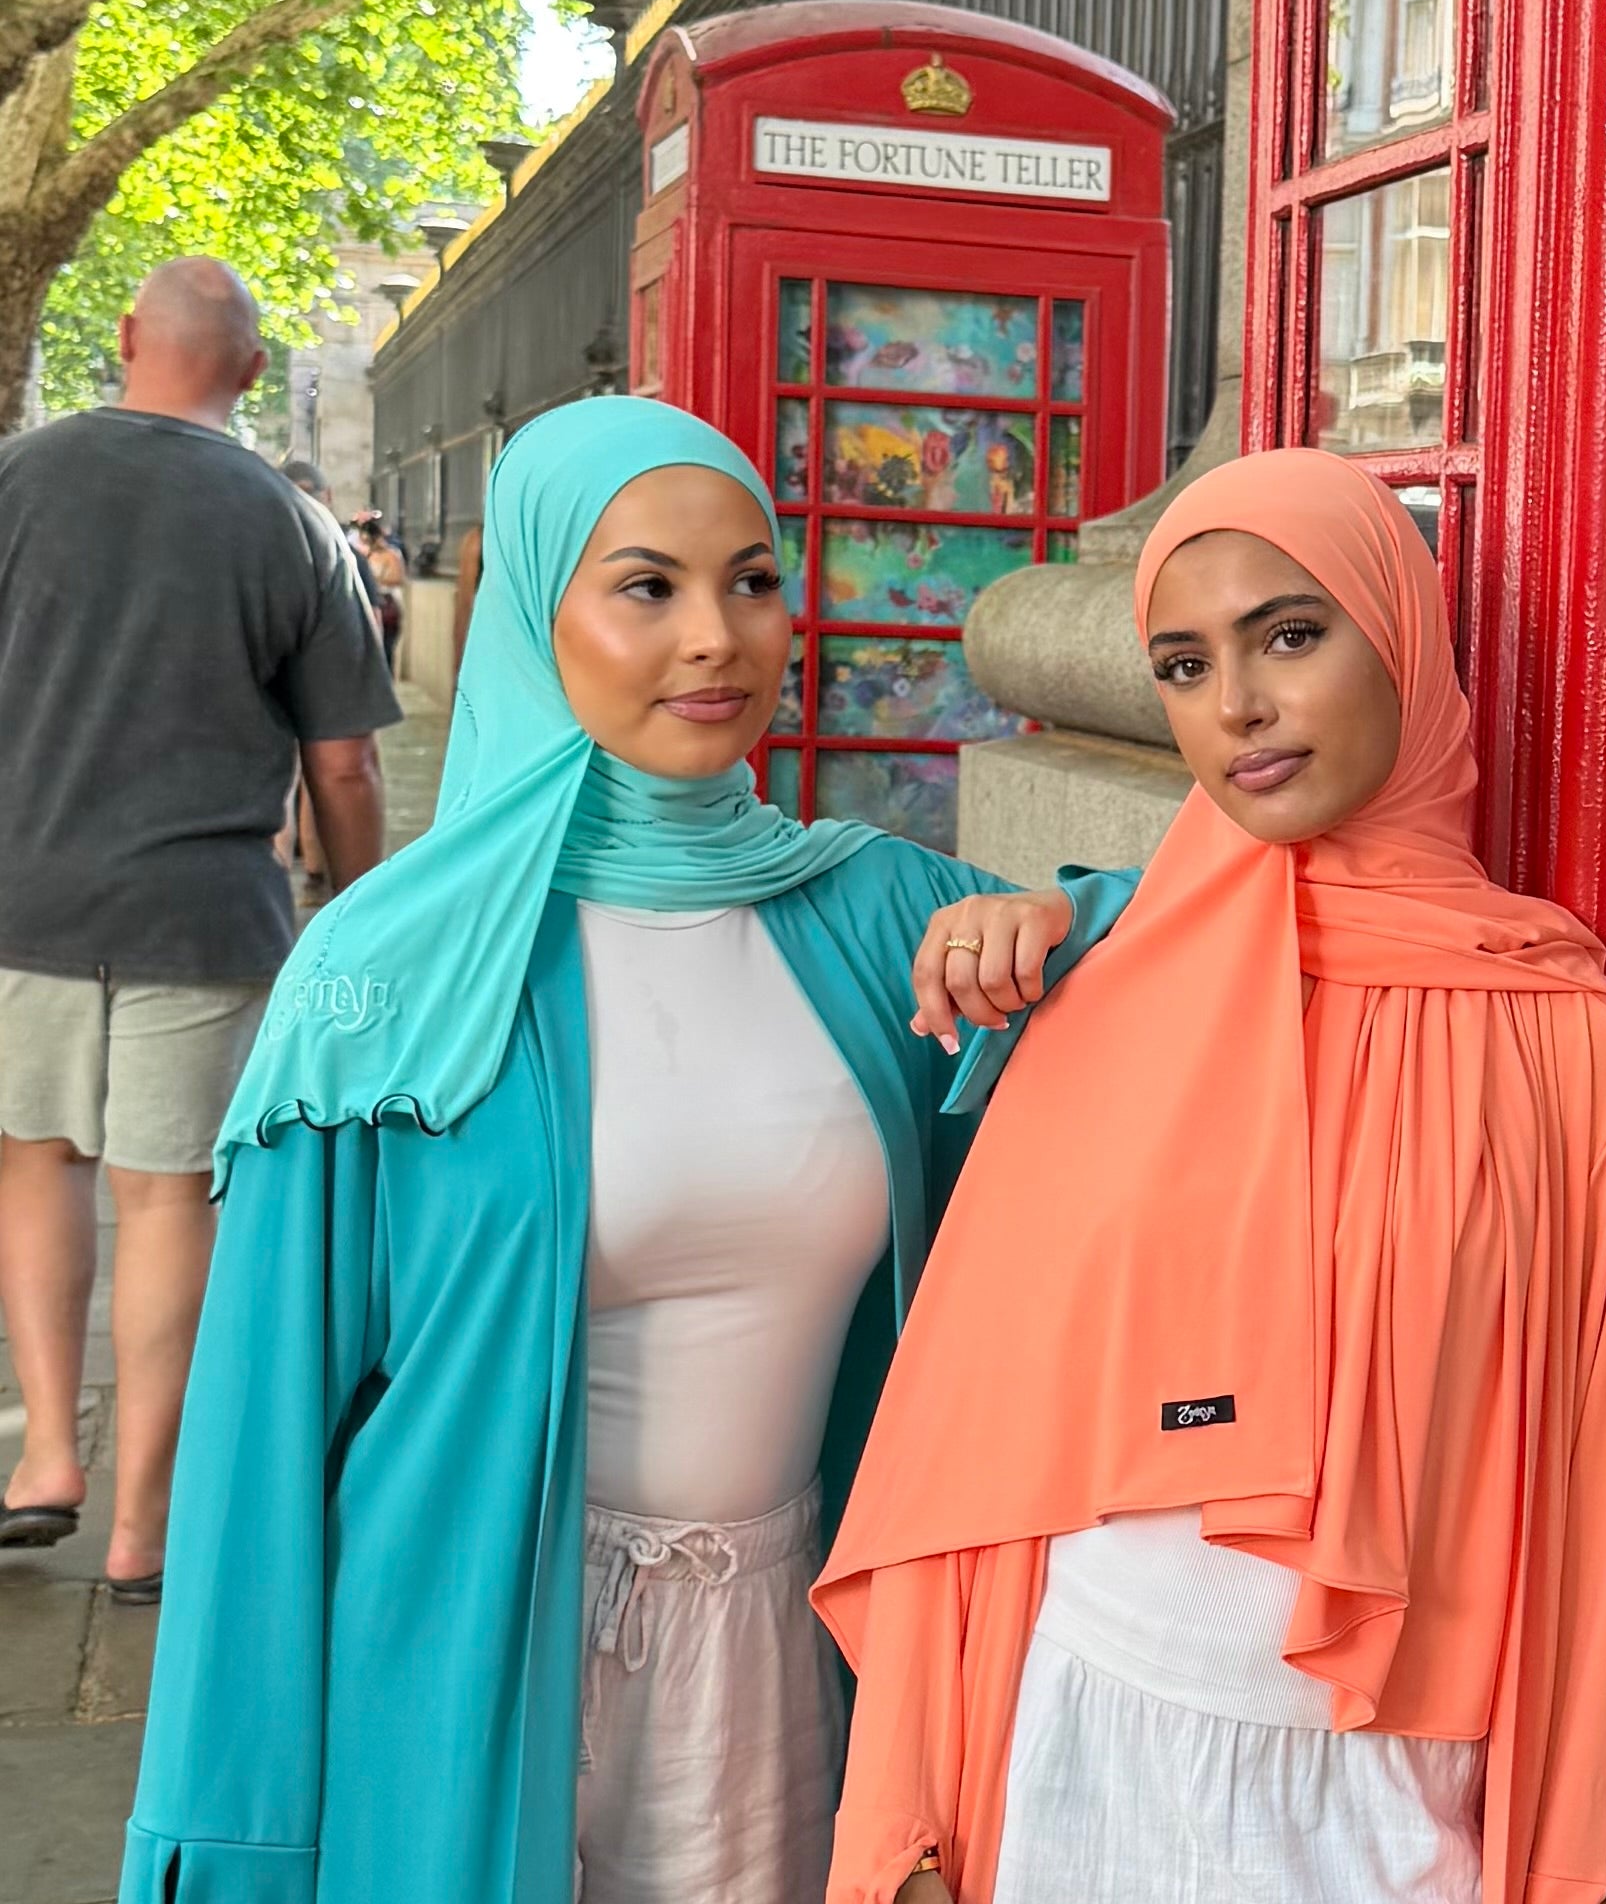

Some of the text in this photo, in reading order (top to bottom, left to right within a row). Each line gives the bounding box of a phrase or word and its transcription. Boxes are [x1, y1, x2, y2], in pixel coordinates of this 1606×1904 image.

[763, 132, 1104, 192] THE FORTUNE TELLER
